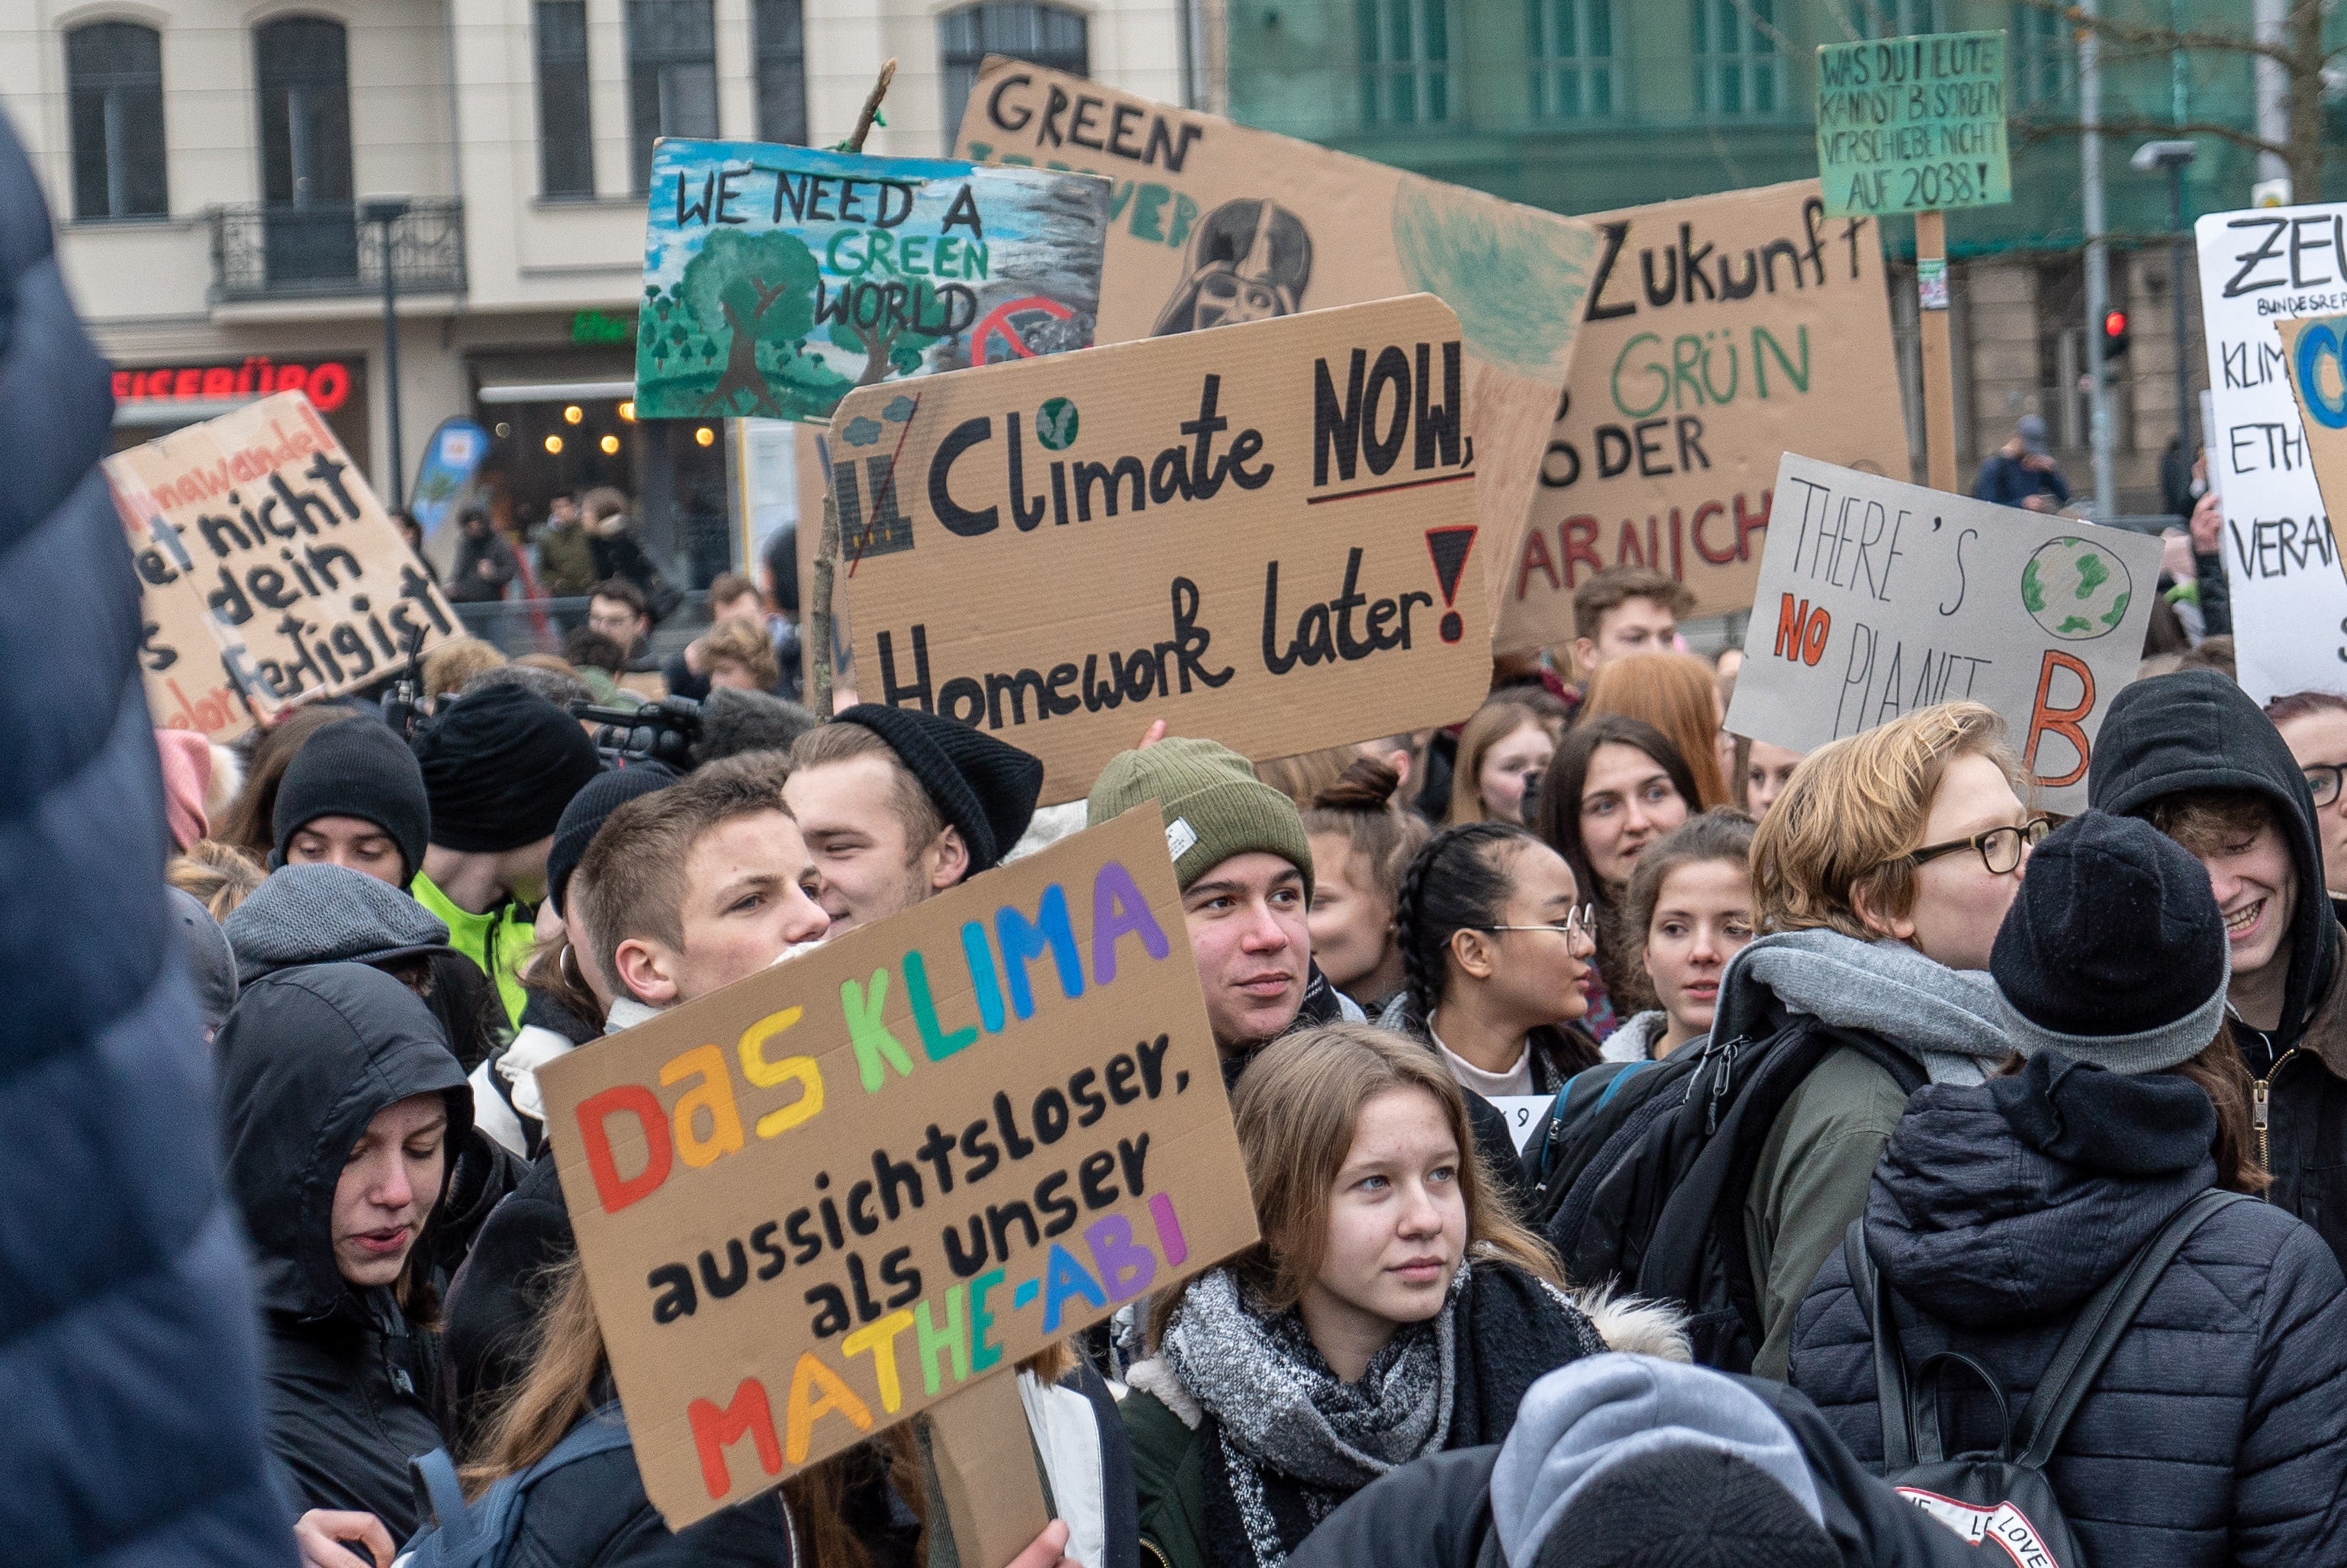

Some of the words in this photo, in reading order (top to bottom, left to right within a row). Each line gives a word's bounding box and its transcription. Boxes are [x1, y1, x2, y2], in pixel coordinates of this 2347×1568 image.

[1821, 44, 1869, 87] WAS
[1875, 43, 1908, 82] DU
[986, 73, 1203, 173] GREEN
[1940, 121, 2003, 157] NICHT
[676, 165, 753, 227] WE
[772, 171, 913, 228] NEED
[940, 184, 983, 238] A
[1846, 167, 1892, 210] AUF
[826, 228, 990, 281] GREEN
[1584, 196, 1867, 322] Zukunft
[813, 279, 979, 336] WORLD
[1611, 323, 1811, 419] GRÜN
[926, 372, 1275, 538] Climate
[1312, 340, 1474, 487] NOW,
[1538, 413, 1711, 488] ODER
[197, 450, 360, 559] nicht
[207, 543, 362, 626] dein
[876, 576, 1235, 731] Homework
[1773, 591, 1832, 668] NO
[2025, 649, 2097, 789] B
[839, 859, 1171, 1094] KLIMA
[646, 1033, 1191, 1326] aussichtsloser,
[803, 1245, 922, 1340] als
[942, 1132, 1151, 1279] unser
[687, 1191, 1190, 1501] MATHE-ABI
